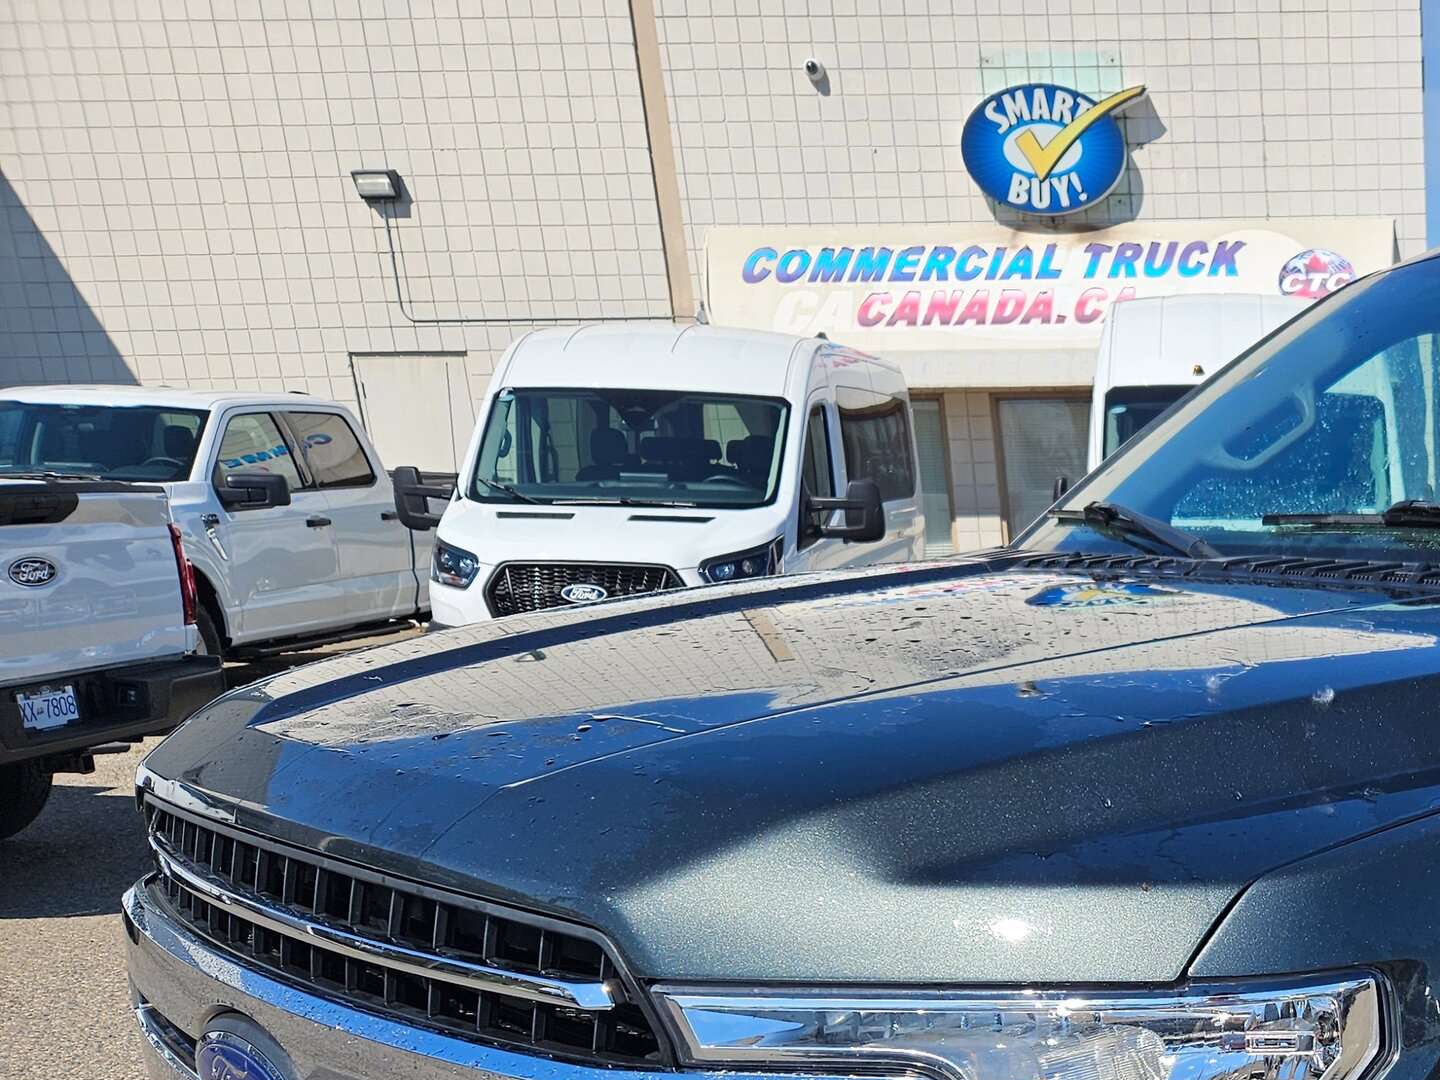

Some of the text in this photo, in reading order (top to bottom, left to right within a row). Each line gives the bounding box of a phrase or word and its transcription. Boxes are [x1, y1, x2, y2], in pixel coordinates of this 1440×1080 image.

[984, 87, 1096, 135] SMART
[1007, 171, 1088, 209] BUY!
[741, 240, 1248, 285] COMMERCIAL TRUCK
[1281, 271, 1351, 294] CTC
[19, 562, 49, 581] Ford
